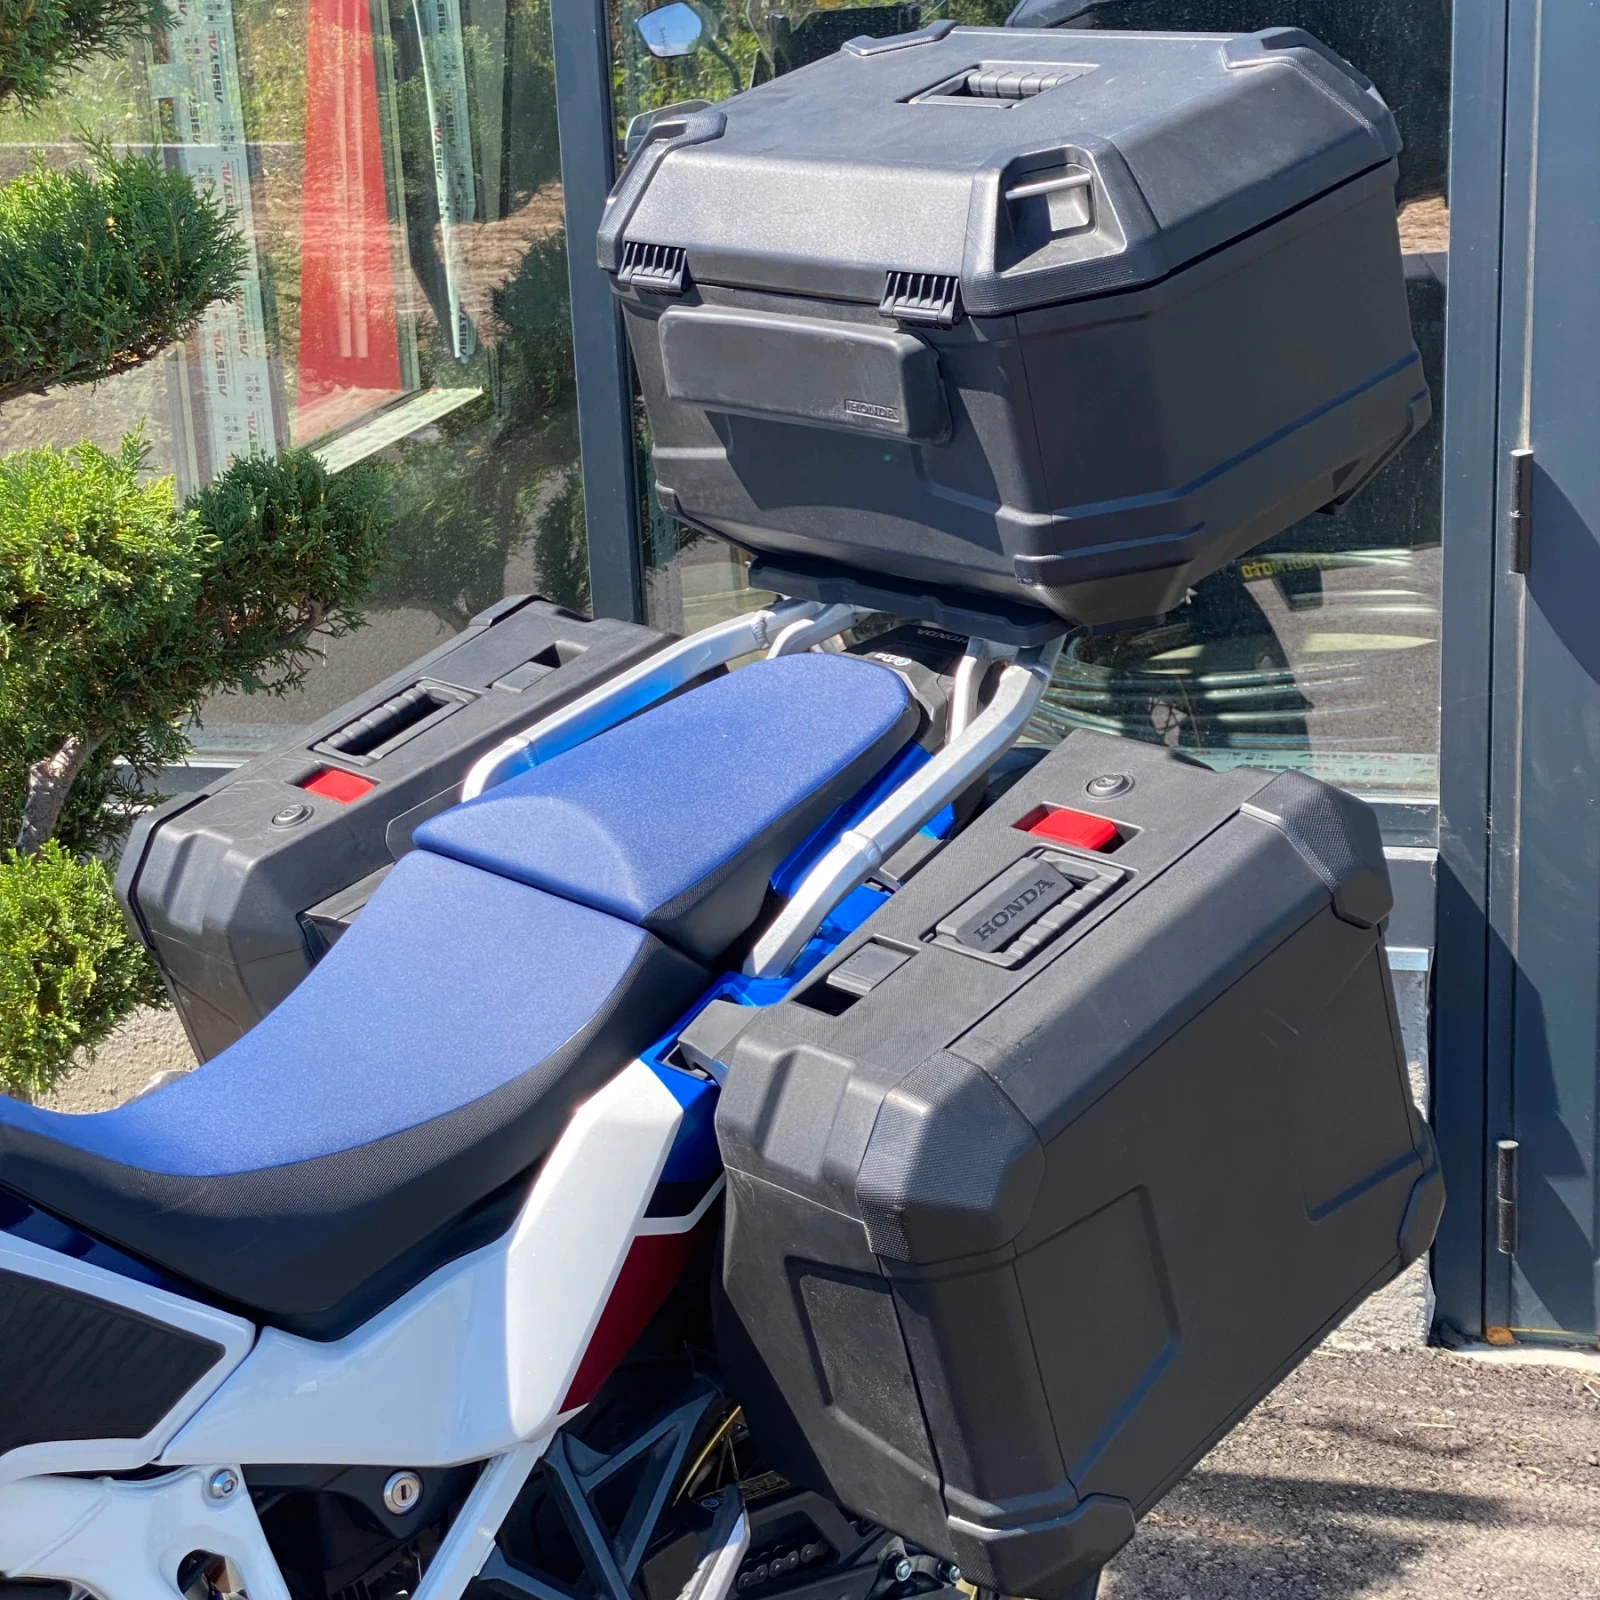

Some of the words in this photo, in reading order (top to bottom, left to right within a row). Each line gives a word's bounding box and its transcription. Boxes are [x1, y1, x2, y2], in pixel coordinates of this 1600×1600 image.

[208, 30, 224, 104] ASISTAL
[443, 87, 456, 148] ASISTAL
[433, 121, 443, 181] ASISTAL
[213, 329, 228, 398] ASISTAL
[848, 401, 898, 420] HONDA
[1297, 753, 1397, 761] ASISTAL
[973, 879, 1056, 942] HONDA
